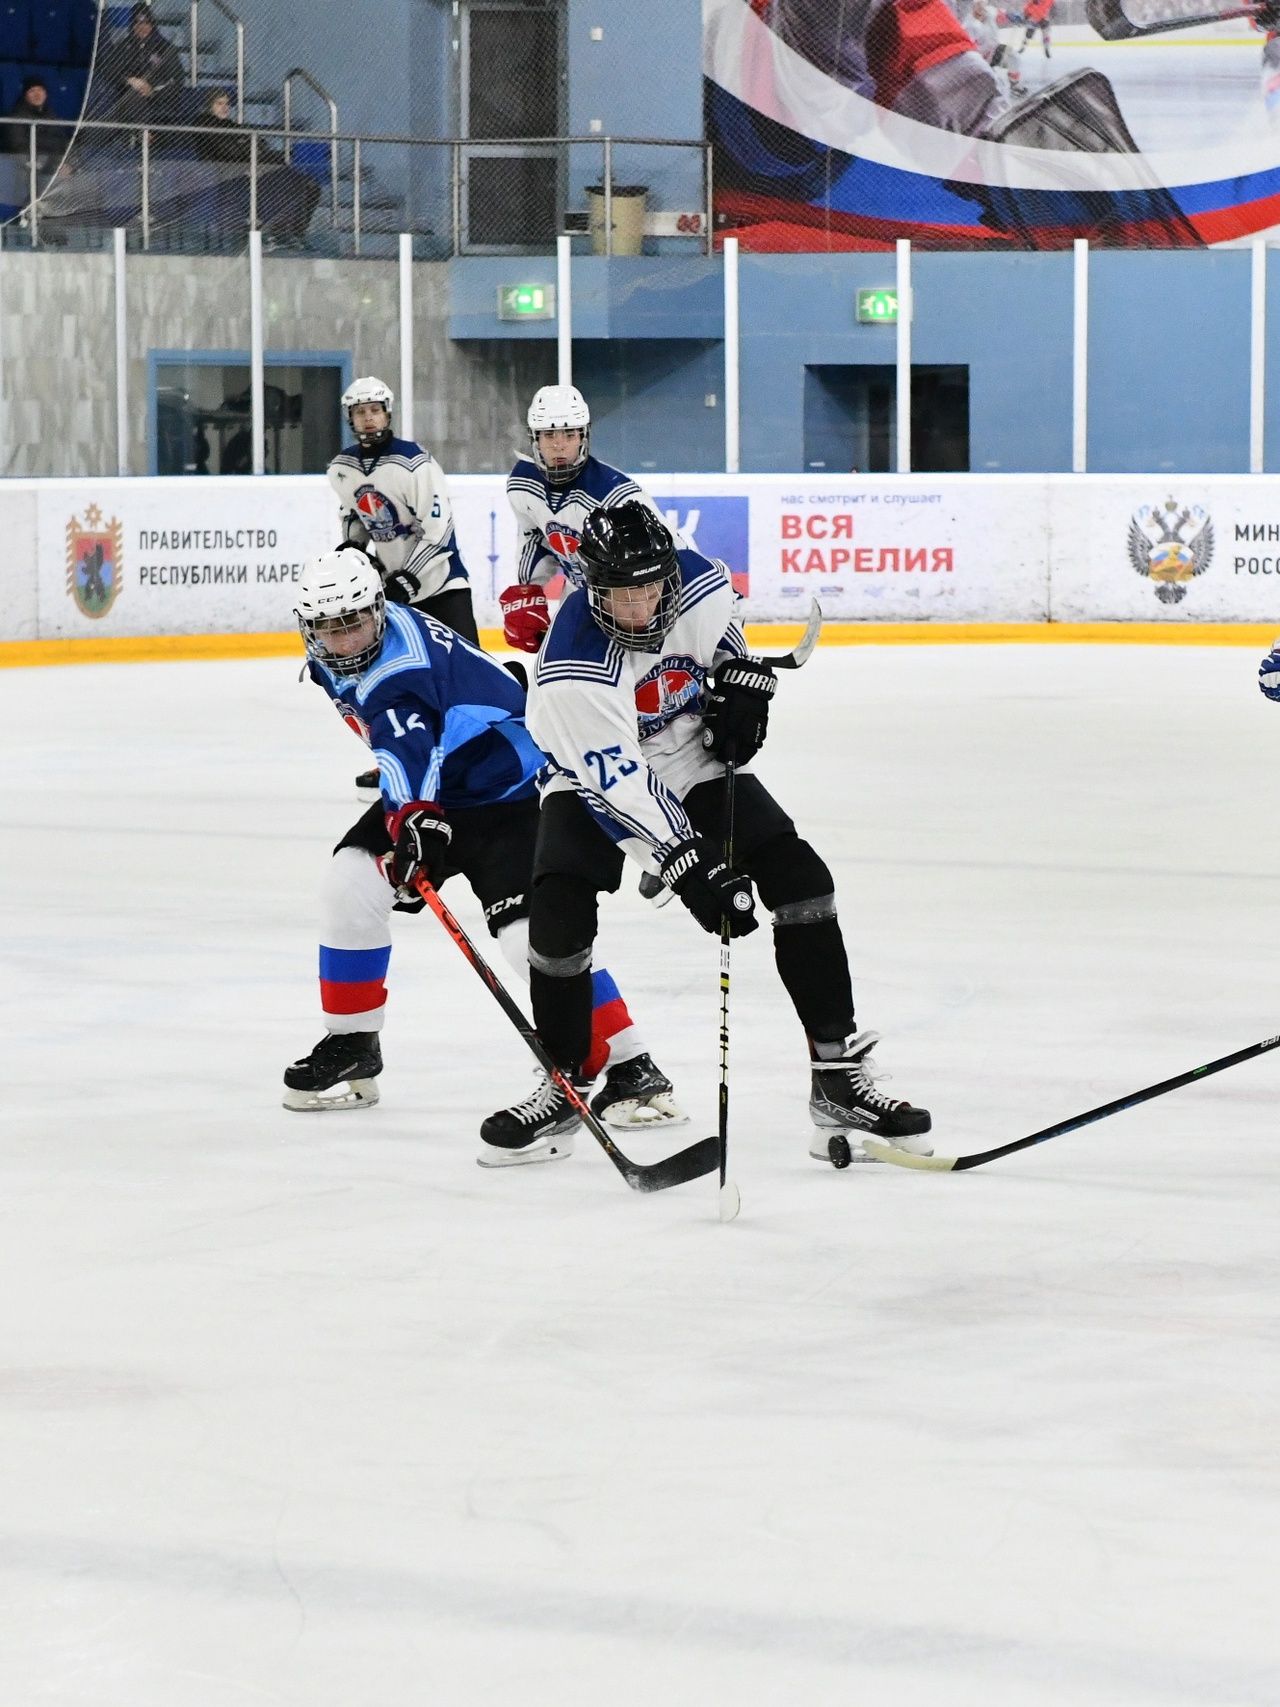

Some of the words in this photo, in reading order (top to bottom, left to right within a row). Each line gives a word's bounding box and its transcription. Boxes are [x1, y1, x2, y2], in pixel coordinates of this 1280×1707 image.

[781, 496, 804, 504] нас
[809, 494, 866, 505] смотрит
[871, 495, 879, 503] и
[883, 494, 942, 505] слушает
[781, 514, 853, 539] ВСЯ
[139, 529, 278, 550] ПРАВИТЕЛЬСТВО
[632, 564, 662, 577] BAUER
[781, 548, 954, 573] КАРЕЛИЯ
[139, 564, 249, 586] РЕСПУБЛИКИ
[256, 563, 304, 583] КАРЕ
[318, 594, 345, 604] CCM
[503, 595, 548, 615] BAUE
[583, 744, 639, 792] 25
